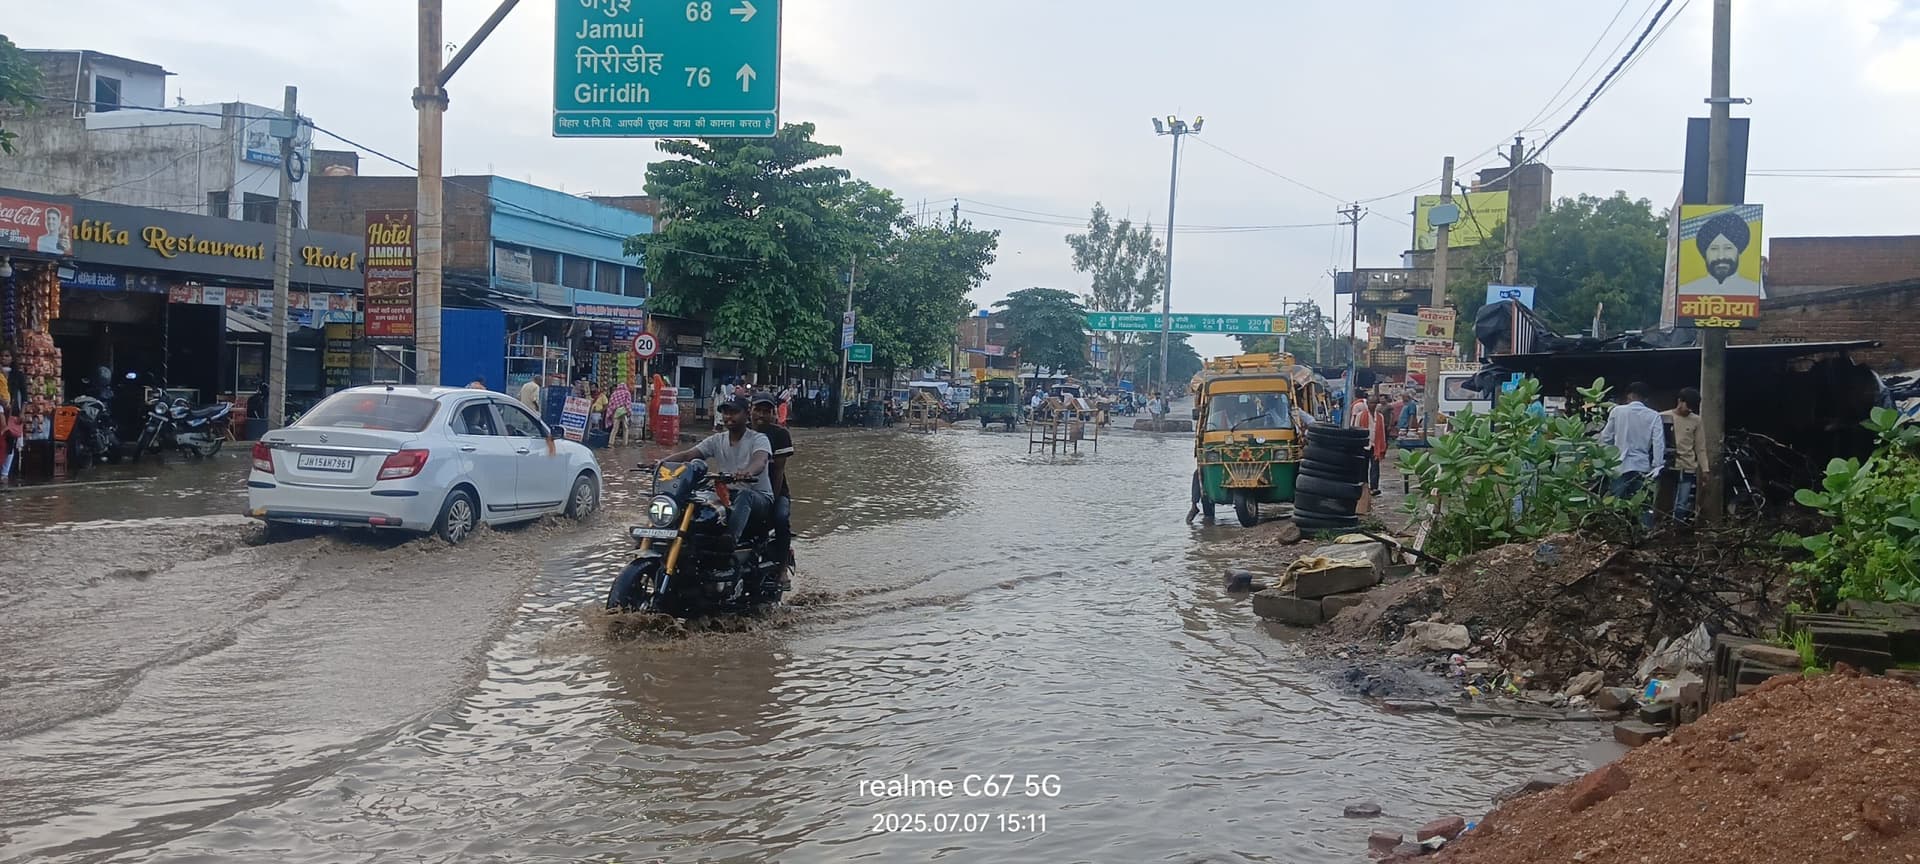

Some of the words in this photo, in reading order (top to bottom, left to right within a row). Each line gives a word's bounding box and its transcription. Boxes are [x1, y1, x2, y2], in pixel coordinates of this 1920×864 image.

[686, 1, 713, 22] 68
[576, 18, 645, 39] Jamui
[575, 45, 664, 75] गिरीडीह
[684, 67, 711, 88] 76
[574, 83, 651, 103] Giridih
[559, 117, 579, 129] बिहार
[618, 117, 643, 129] आपकी
[648, 118, 668, 130] सुखद
[673, 118, 691, 129] यात्रा
[695, 117, 706, 129] की
[710, 118, 736, 129] कामना
[739, 118, 761, 129] करता
[765, 117, 772, 129] है
[0, 203, 42, 227] ca-Cola
[142, 226, 266, 260] Restaurant
[368, 223, 412, 245] Hotel
[302, 245, 358, 272] Hotel
[368, 246, 413, 266] AMBIKA
[638, 339, 653, 350] 20
